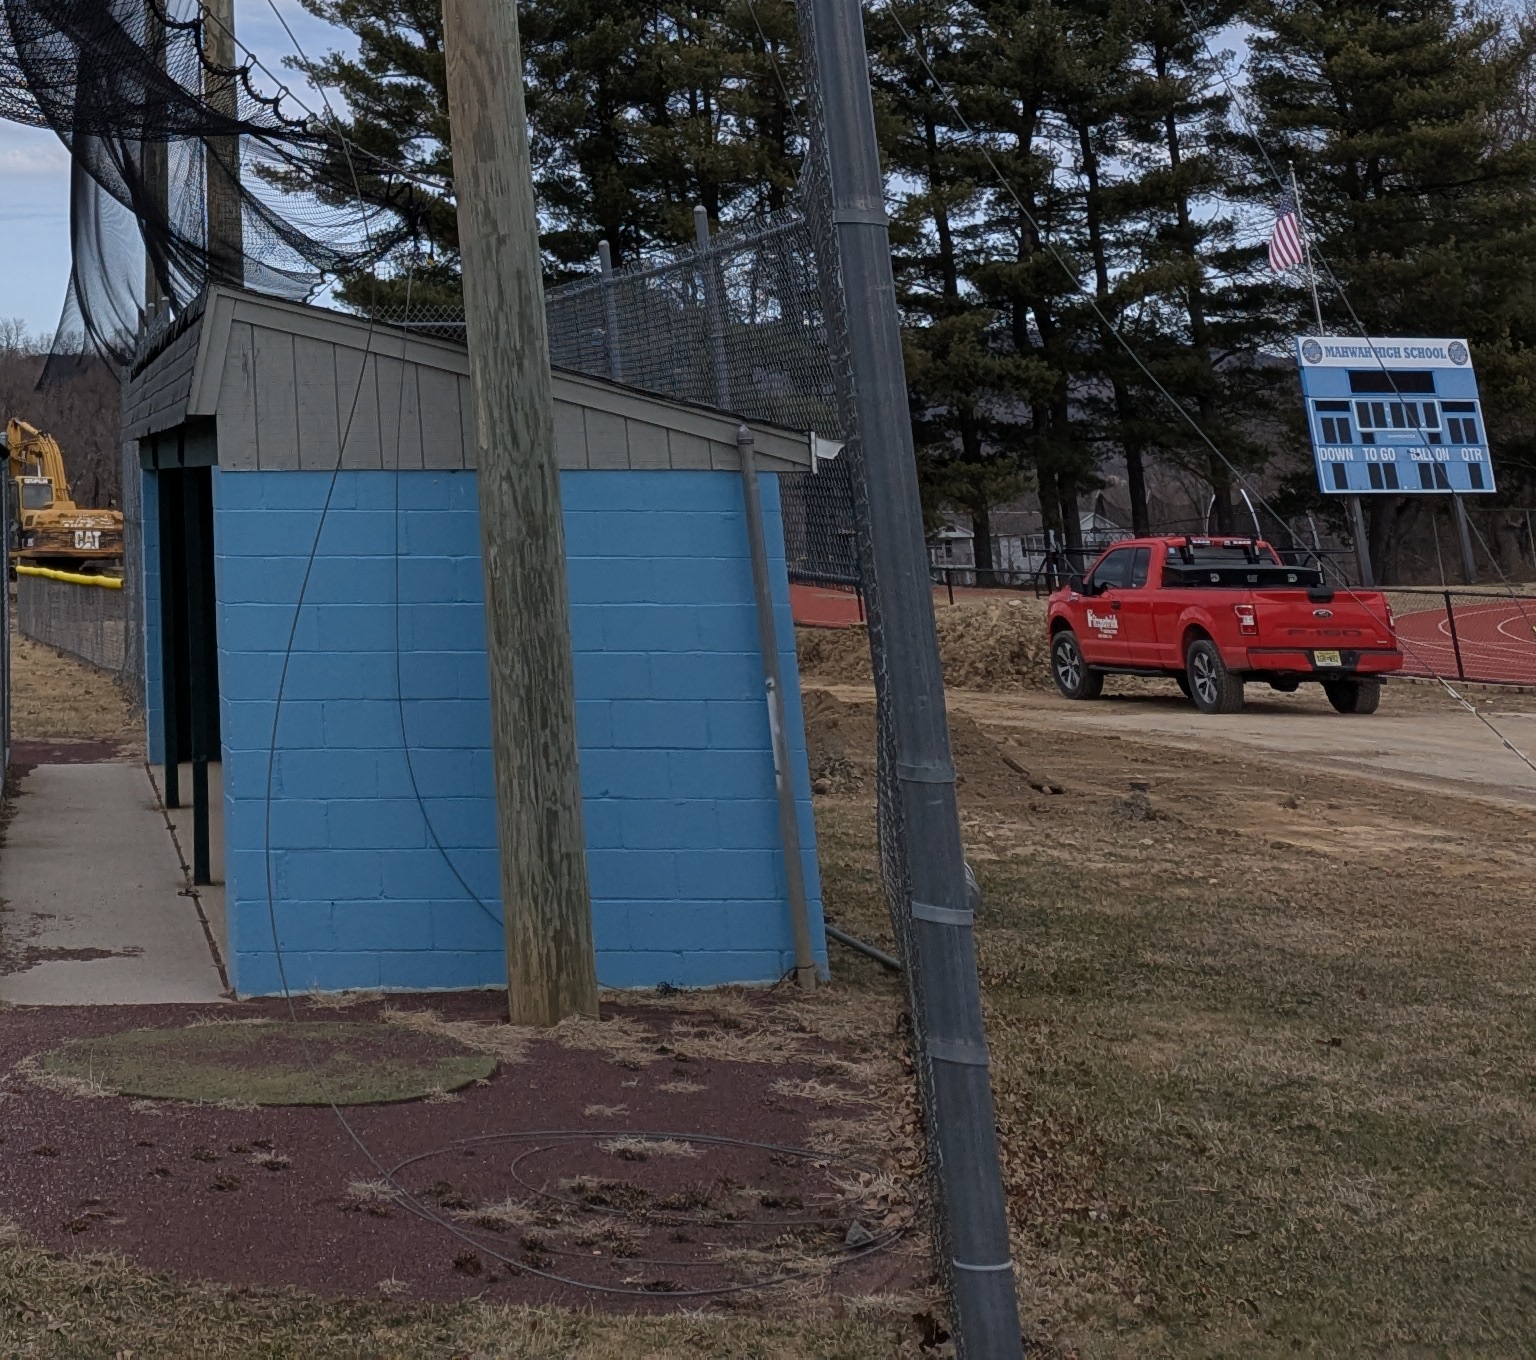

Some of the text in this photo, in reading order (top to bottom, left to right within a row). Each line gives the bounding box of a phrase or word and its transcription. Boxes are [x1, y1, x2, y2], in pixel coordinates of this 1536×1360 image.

[1324, 345, 1372, 358] MAHWAH
[1373, 346, 1402, 359] HIGH
[1404, 347, 1447, 360] SCHOOL
[1319, 447, 1354, 462] DOWN
[1363, 448, 1396, 462] TO GO
[1410, 448, 1450, 462] BALL ON
[1460, 448, 1483, 462] QTR
[74, 529, 102, 550] CAT
